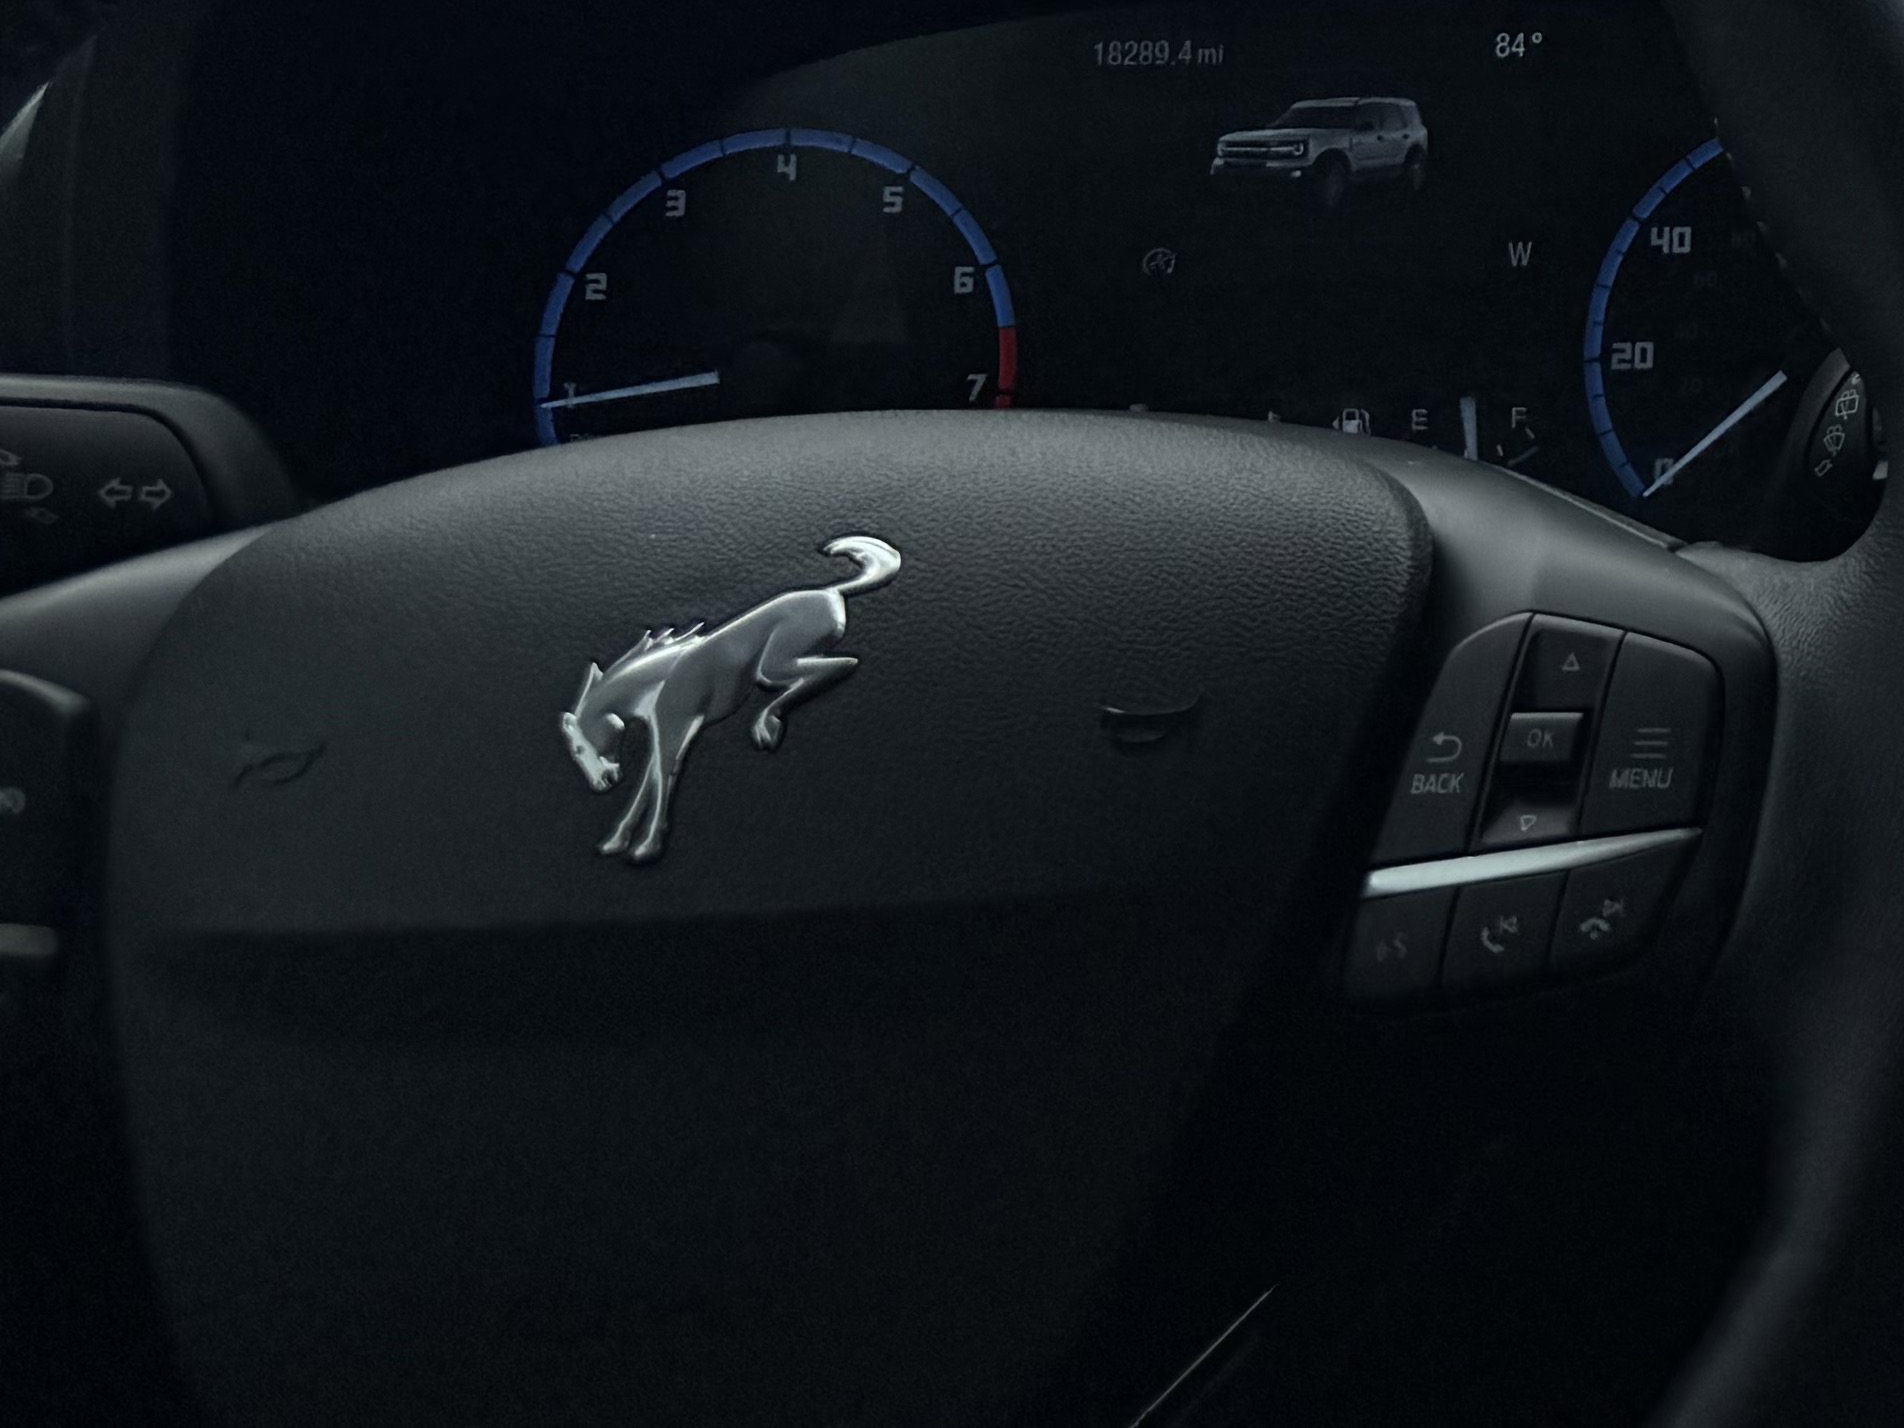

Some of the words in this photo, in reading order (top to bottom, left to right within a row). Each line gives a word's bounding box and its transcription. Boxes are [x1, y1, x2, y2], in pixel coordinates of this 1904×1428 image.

[1093, 39, 1193, 66] 18289.4
[1197, 43, 1225, 65] mi
[776, 153, 798, 182] 4
[664, 188, 687, 218] 3
[882, 185, 904, 214] 5
[1507, 240, 1533, 267] W
[1649, 225, 1692, 254] 40
[584, 271, 608, 302] 2
[952, 265, 975, 295] 6
[1610, 341, 1655, 371] 20
[964, 372, 988, 402] 7
[1411, 407, 1428, 431] E
[1510, 406, 1528, 429] F
[1526, 728, 1554, 749] OK
[1409, 772, 1465, 795] BACK
[1608, 767, 1674, 790] MENU
